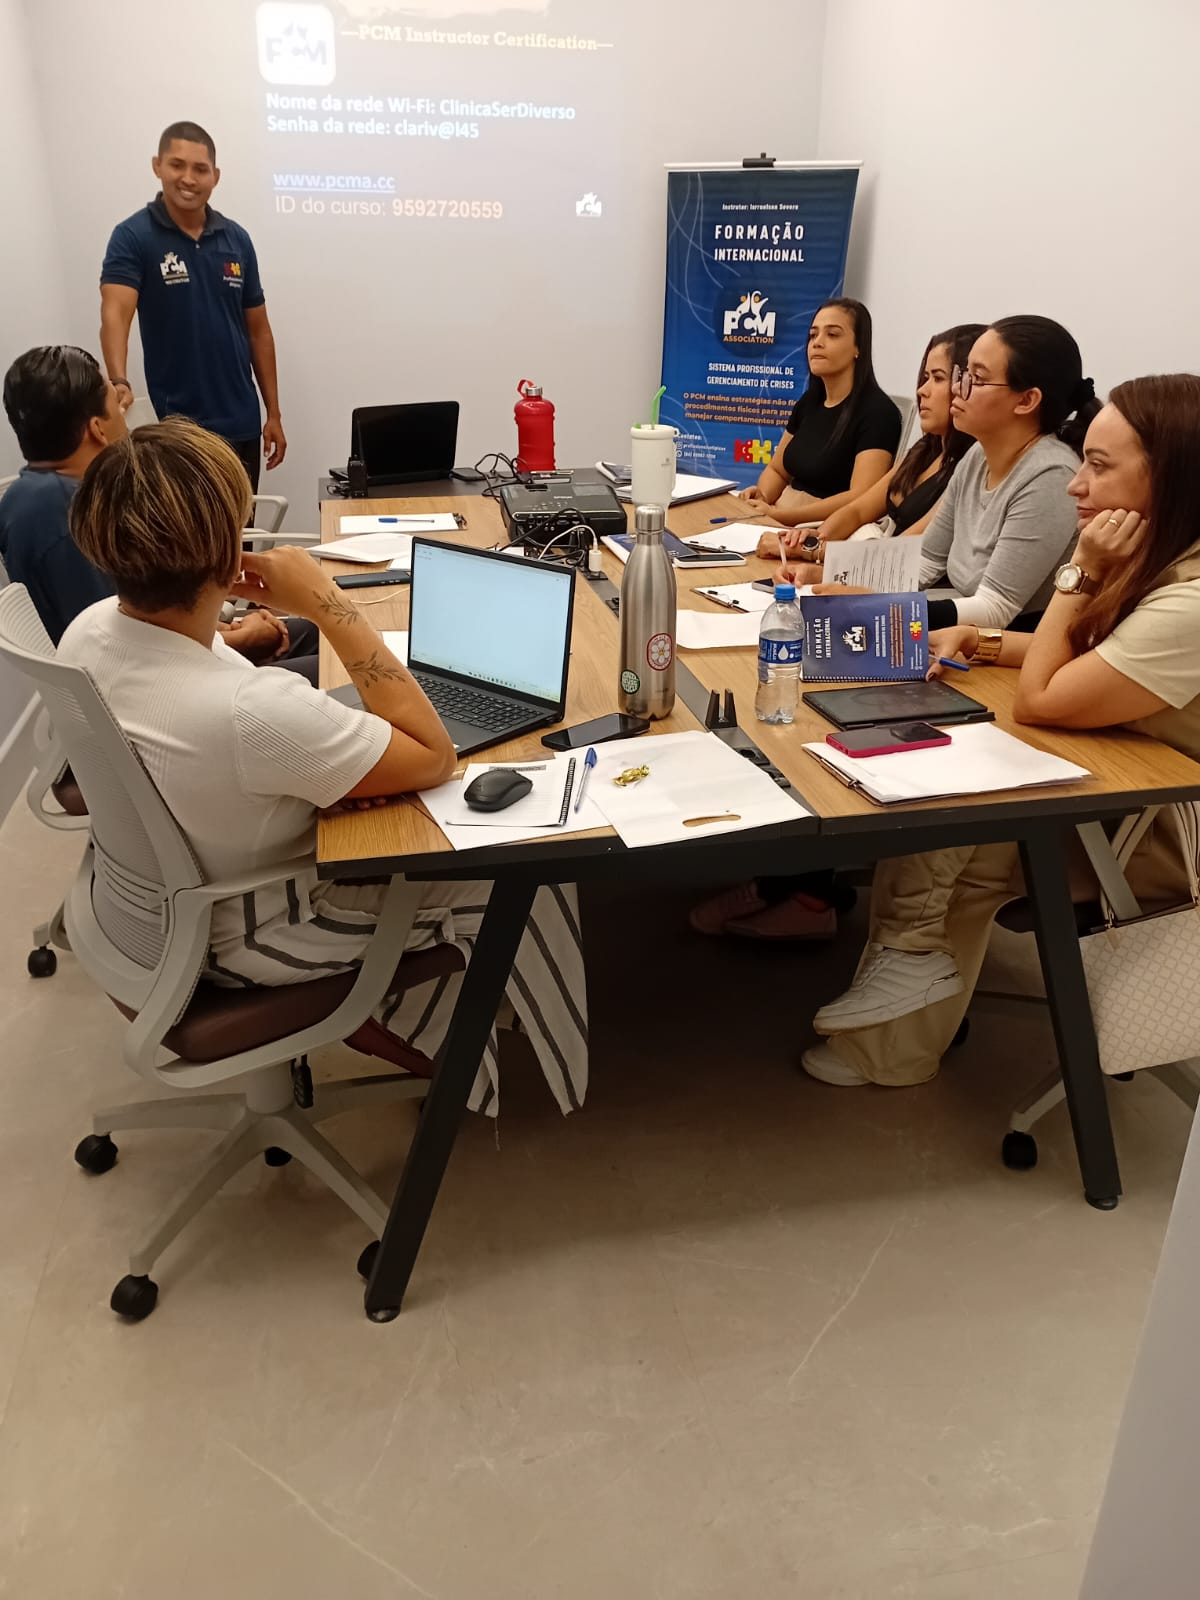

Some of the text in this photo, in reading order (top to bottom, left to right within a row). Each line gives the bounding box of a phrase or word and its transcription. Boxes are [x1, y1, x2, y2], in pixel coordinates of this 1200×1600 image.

[406, 27, 490, 45] Instructor
[266, 93, 576, 120] Nome da rede Wi-Fi: ClinicaSerDiverso
[267, 115, 319, 132] Senha
[323, 116, 344, 133] da
[347, 118, 391, 135] rede:
[273, 173, 396, 190] www.pcma.cc
[275, 196, 503, 219] ID do curso: 9592720559
[715, 222, 804, 245] FORMAÇÃO
[714, 248, 804, 262] INTERNACIONAL
[723, 310, 776, 337] PCM
[723, 335, 774, 344] ASSOCIATION
[708, 362, 794, 376] SISTEMA PROFISSIONAL DE
[707, 376, 794, 389] GERENCIAMENTO DE CRISES
[684, 402, 736, 412] procedimentos
[707, 394, 730, 402] ensina
[772, 398, 786, 406] não
[685, 412, 713, 420] manejar
[714, 414, 774, 424] comportamentos
[813, 618, 823, 659] FORMAÇÃO
